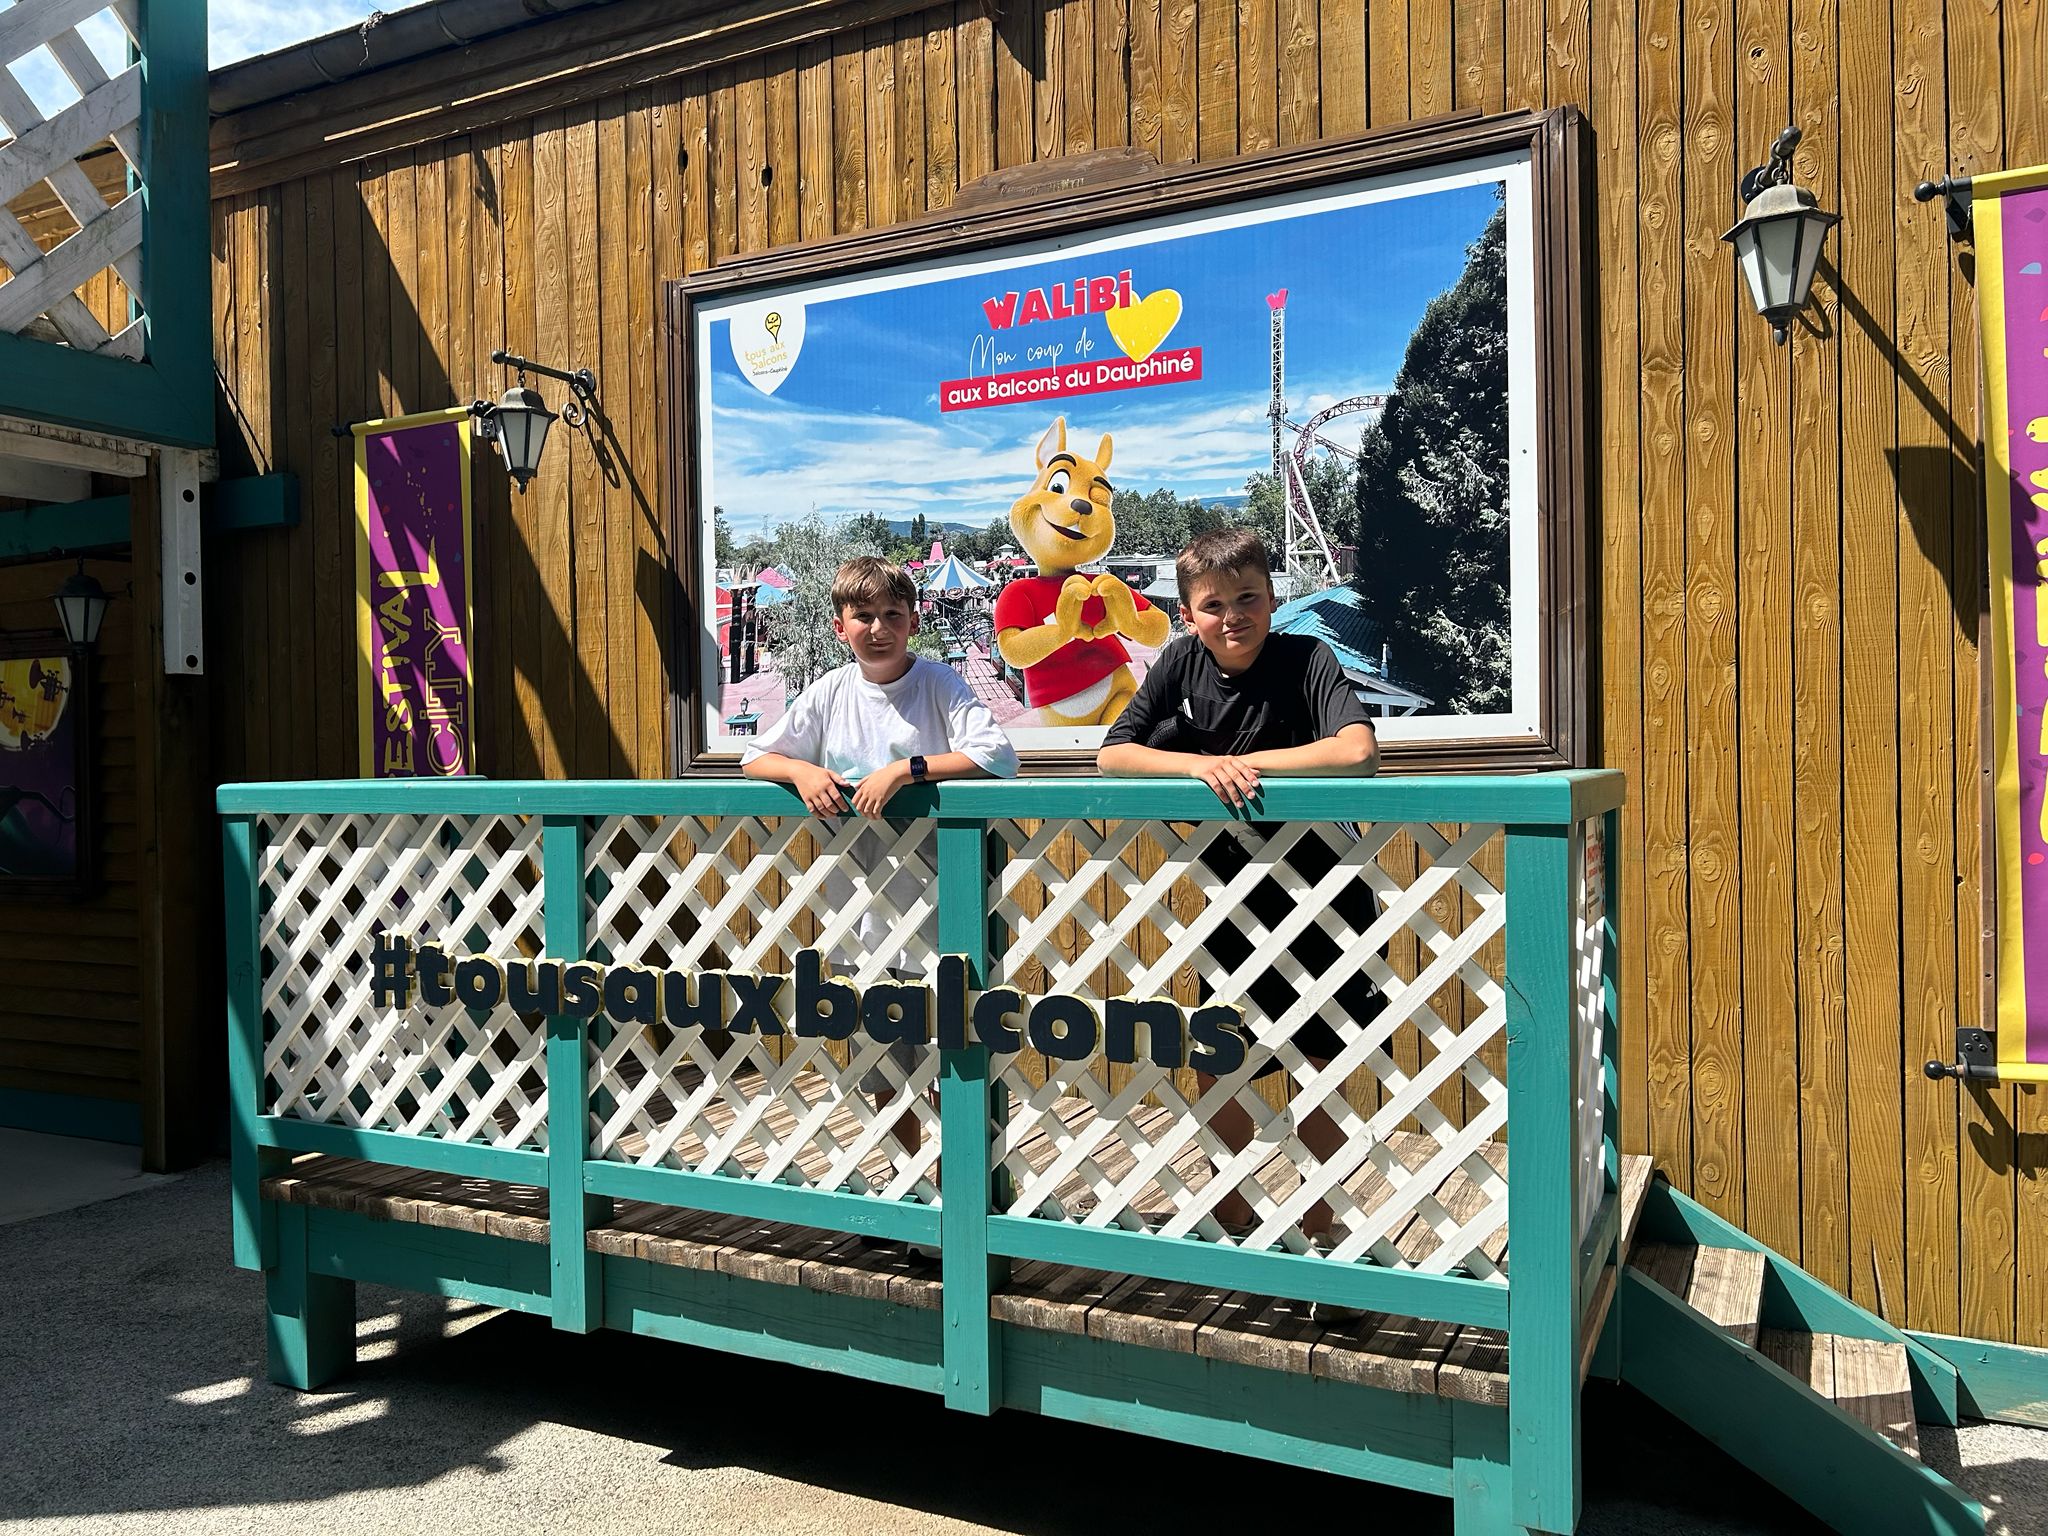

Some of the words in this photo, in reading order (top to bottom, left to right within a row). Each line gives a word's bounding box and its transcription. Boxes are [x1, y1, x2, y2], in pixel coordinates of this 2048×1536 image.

[769, 341, 785, 353] aux
[969, 333, 1018, 380] Mon
[1027, 341, 1064, 376] coup
[1075, 326, 1096, 359] de
[948, 385, 982, 406] aux
[987, 373, 1061, 398] Balcons
[1065, 368, 1091, 390] du
[1096, 351, 1194, 382] Dauphiné
[377, 534, 440, 777] ESTIVAL
[370, 930, 1253, 1077] #tousauxbalcons
